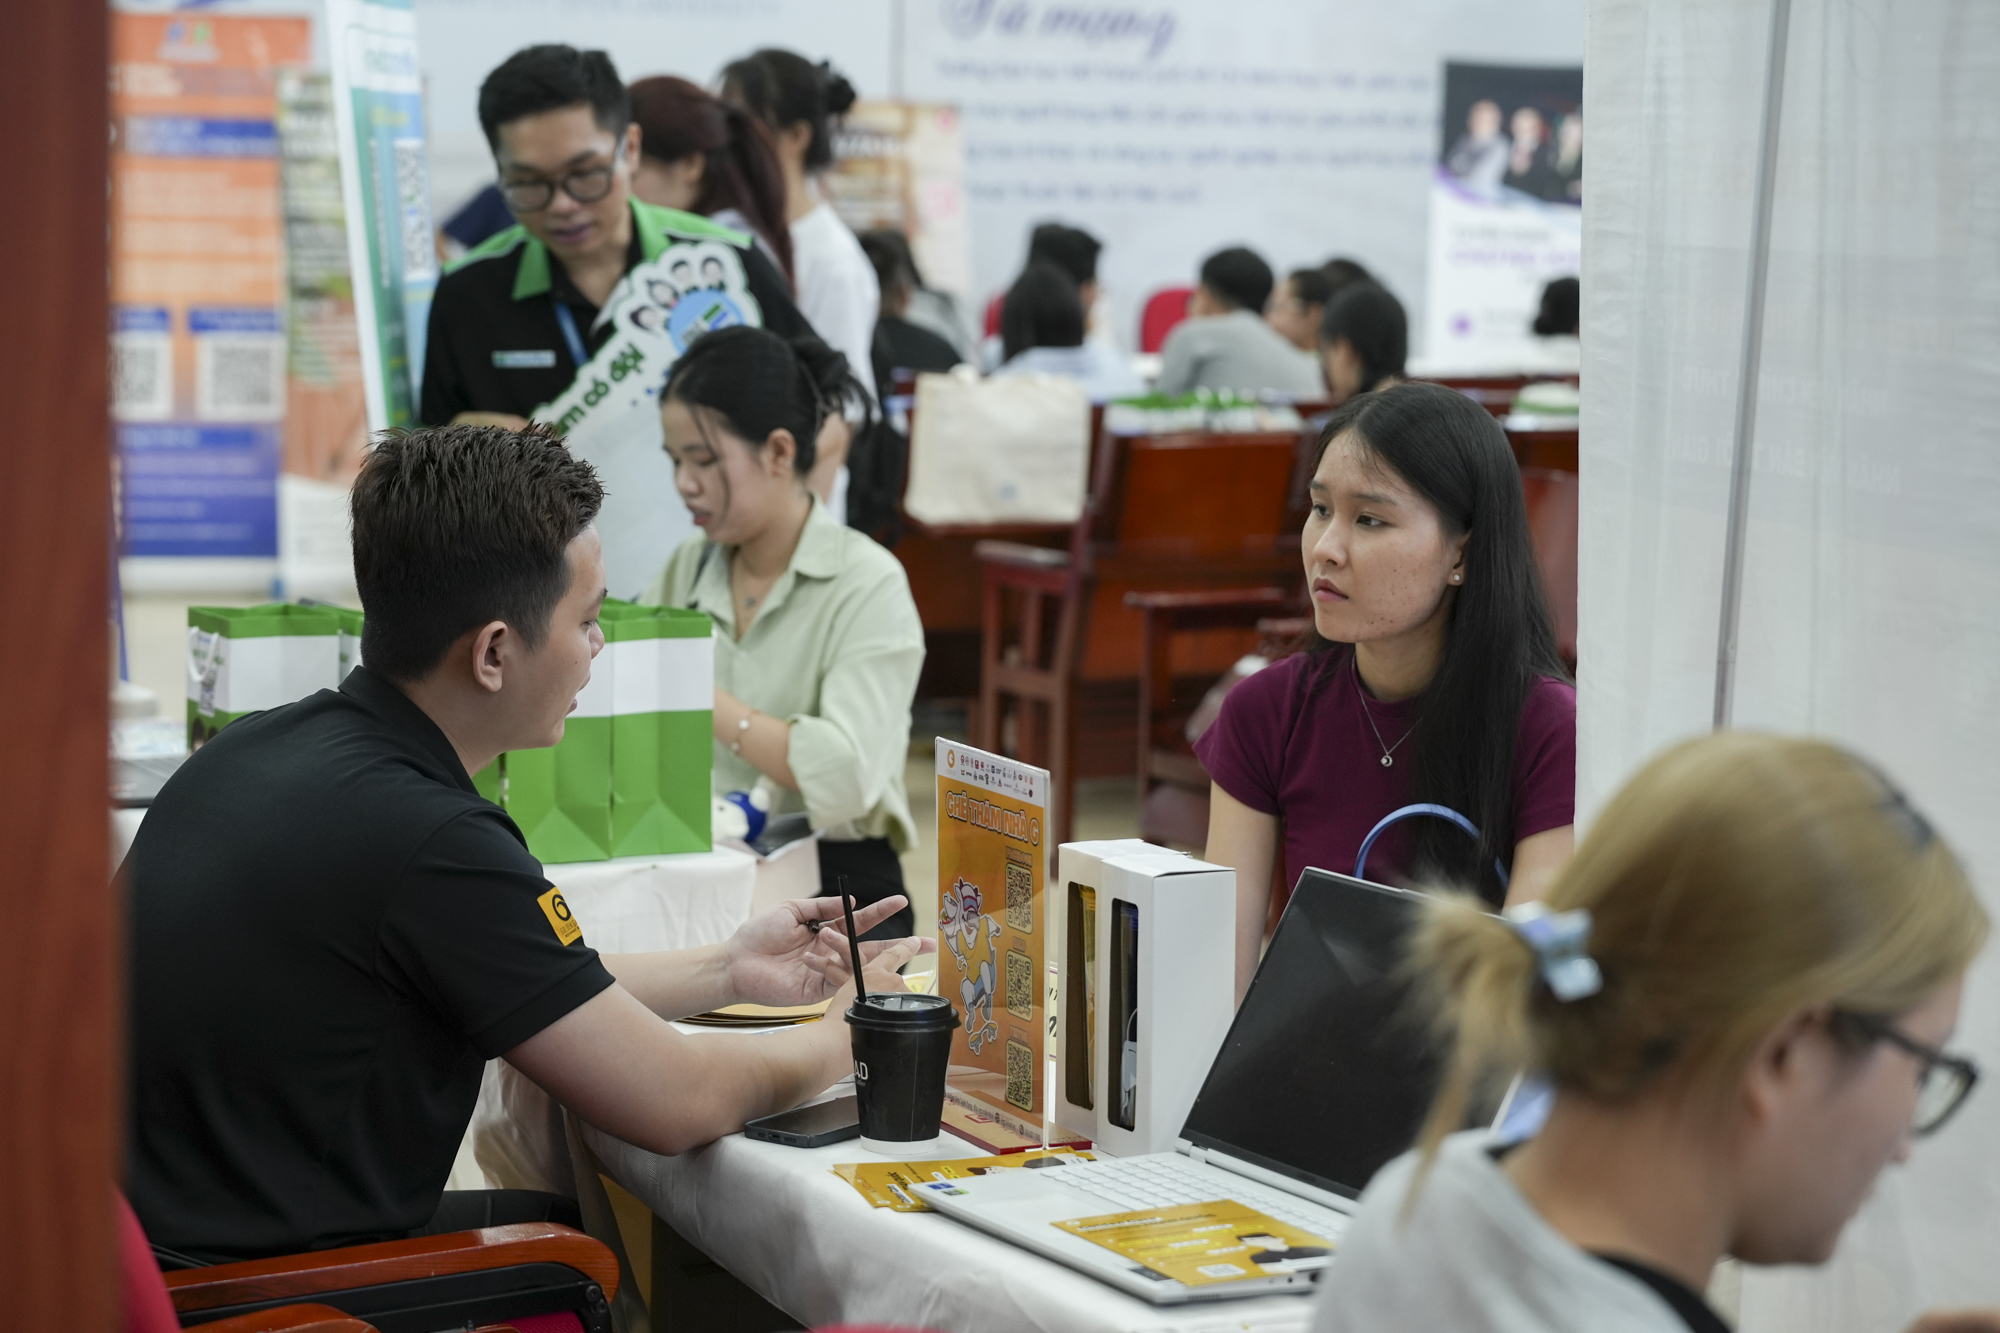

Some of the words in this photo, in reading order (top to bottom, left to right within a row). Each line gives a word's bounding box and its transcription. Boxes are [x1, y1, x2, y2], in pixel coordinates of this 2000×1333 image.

[583, 377, 609, 406] có
[946, 790, 968, 821] GHÉ
[968, 798, 1002, 833] THĂM
[1003, 809, 1028, 843] NHÀ
[1029, 817, 1040, 847] G
